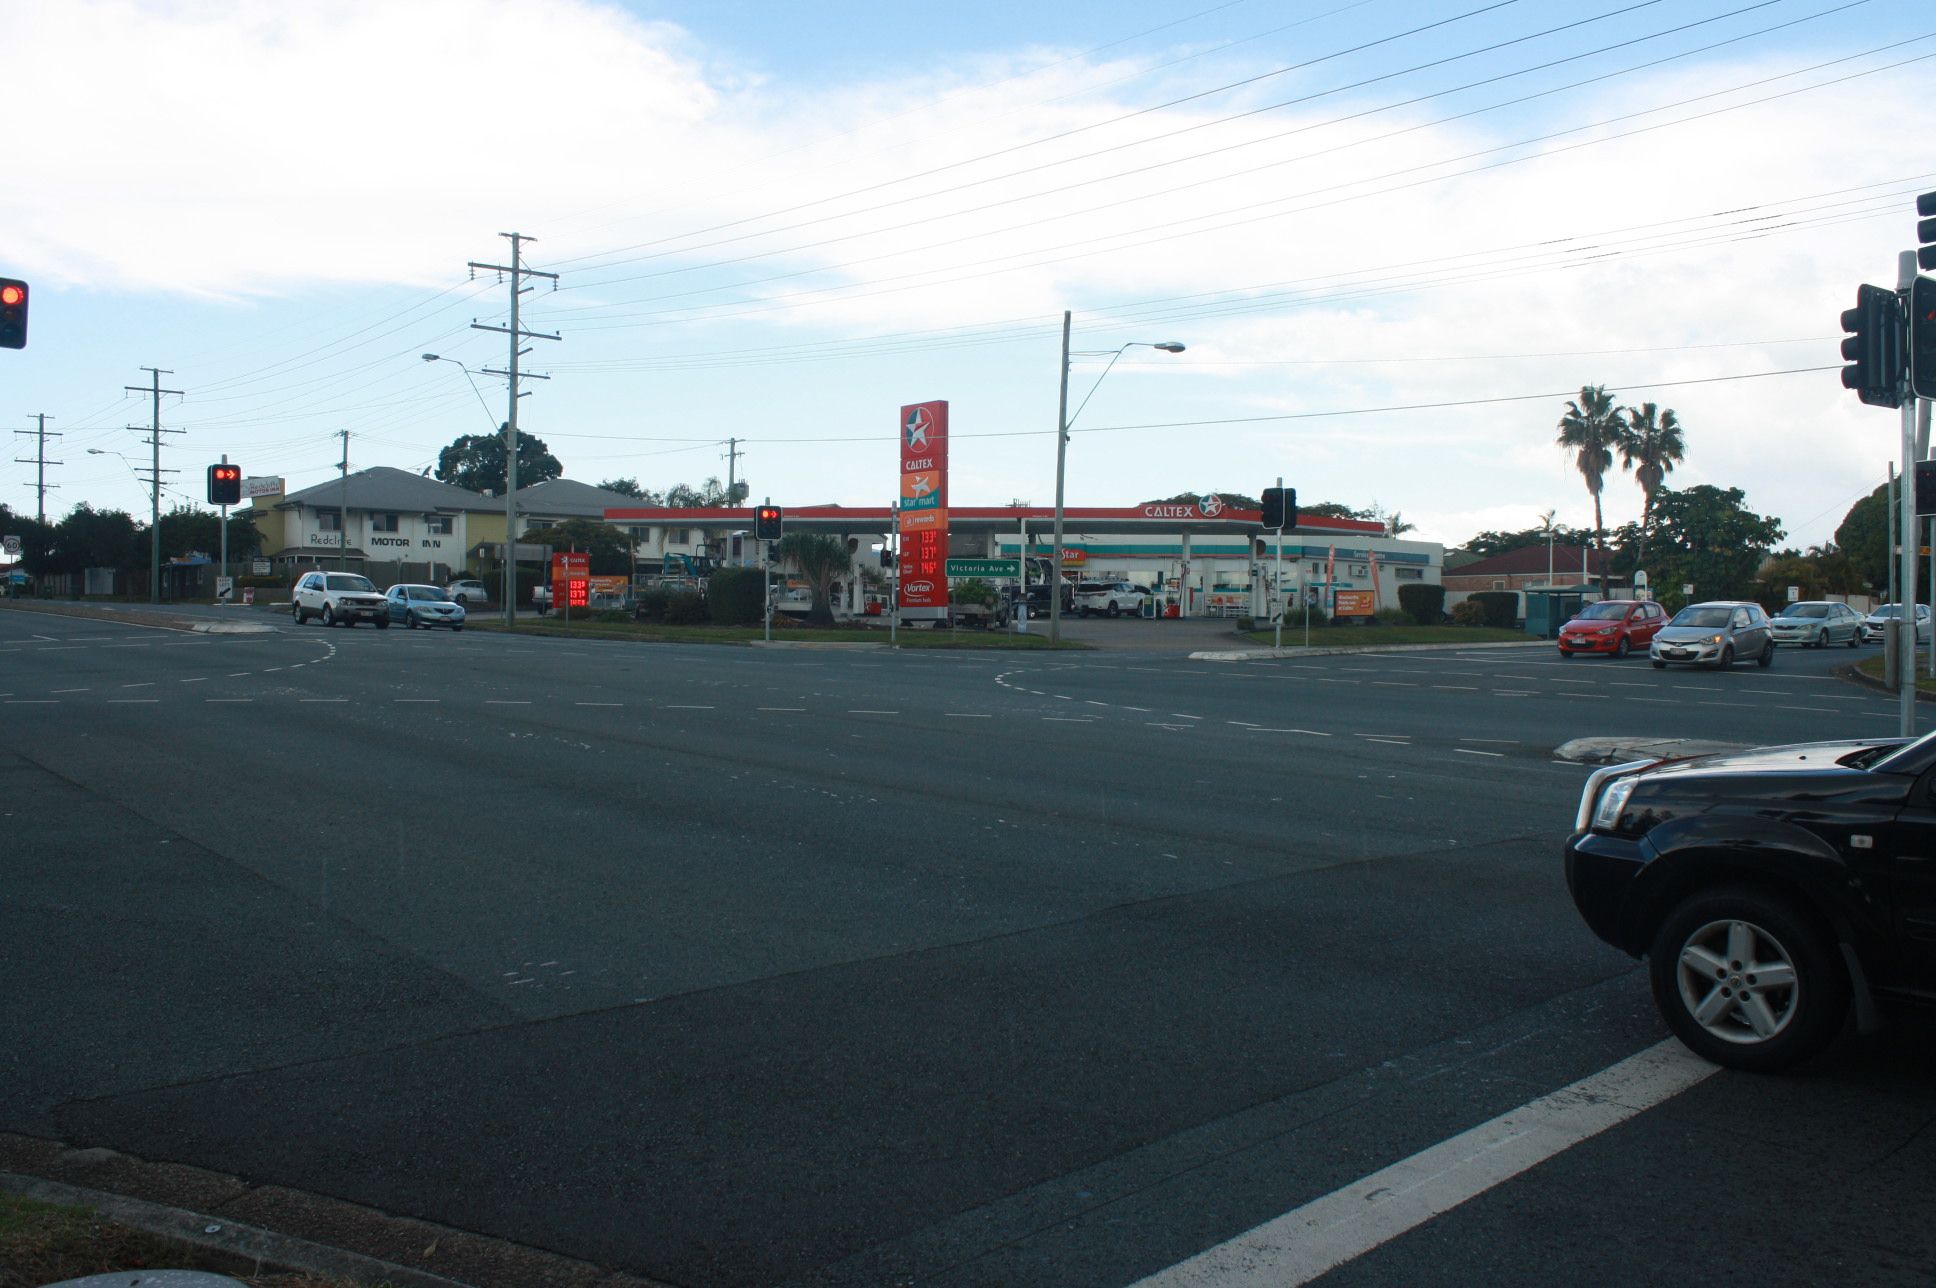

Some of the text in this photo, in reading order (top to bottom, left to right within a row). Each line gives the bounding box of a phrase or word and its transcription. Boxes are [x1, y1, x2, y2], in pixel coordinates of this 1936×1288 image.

[905, 459, 933, 470] CALTEX
[904, 497, 934, 507] star mart
[1145, 506, 1193, 517] CALTEX
[371, 537, 441, 548] MOTOR INN
[950, 564, 985, 572] Victoria
[907, 583, 930, 593] Vortex
